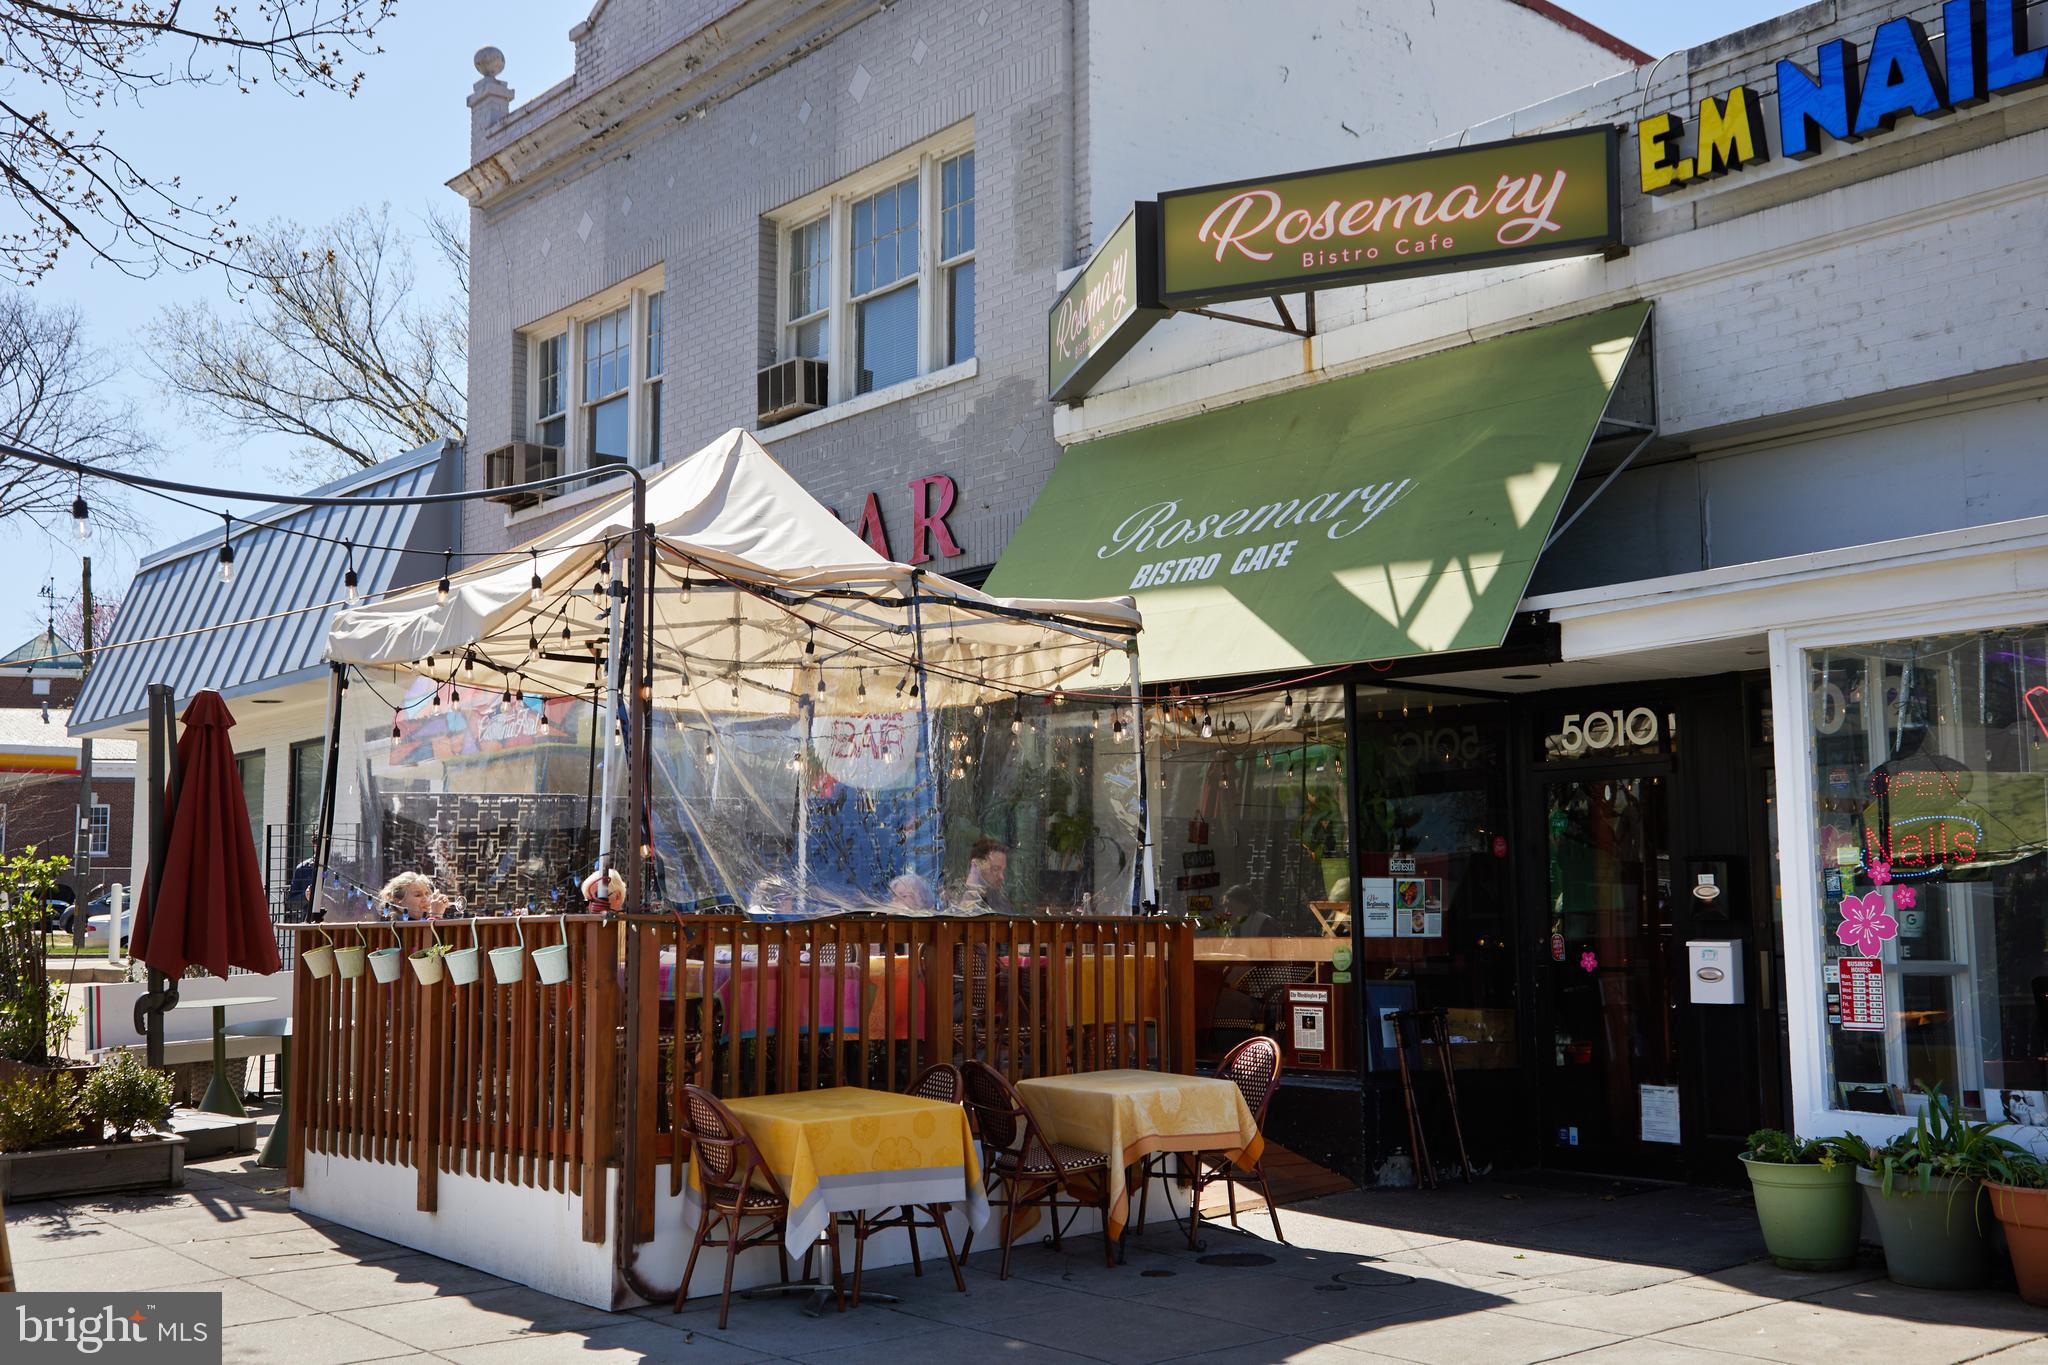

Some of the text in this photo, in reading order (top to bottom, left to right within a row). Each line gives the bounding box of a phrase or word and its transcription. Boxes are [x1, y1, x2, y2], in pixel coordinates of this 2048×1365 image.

[1776, 0, 2048, 159] NAIL
[1198, 170, 1567, 263] Rosemary
[1302, 233, 1455, 268] Bistro Cafe
[1056, 249, 1128, 362] Rosemary
[828, 474, 963, 566] AR
[1097, 478, 1420, 560] Rosemary
[1129, 540, 1299, 590] BISTRO CAFE
[1561, 707, 1658, 750] 5010
[1869, 770, 1962, 798] OPEN
[1865, 822, 1978, 866] Nails
